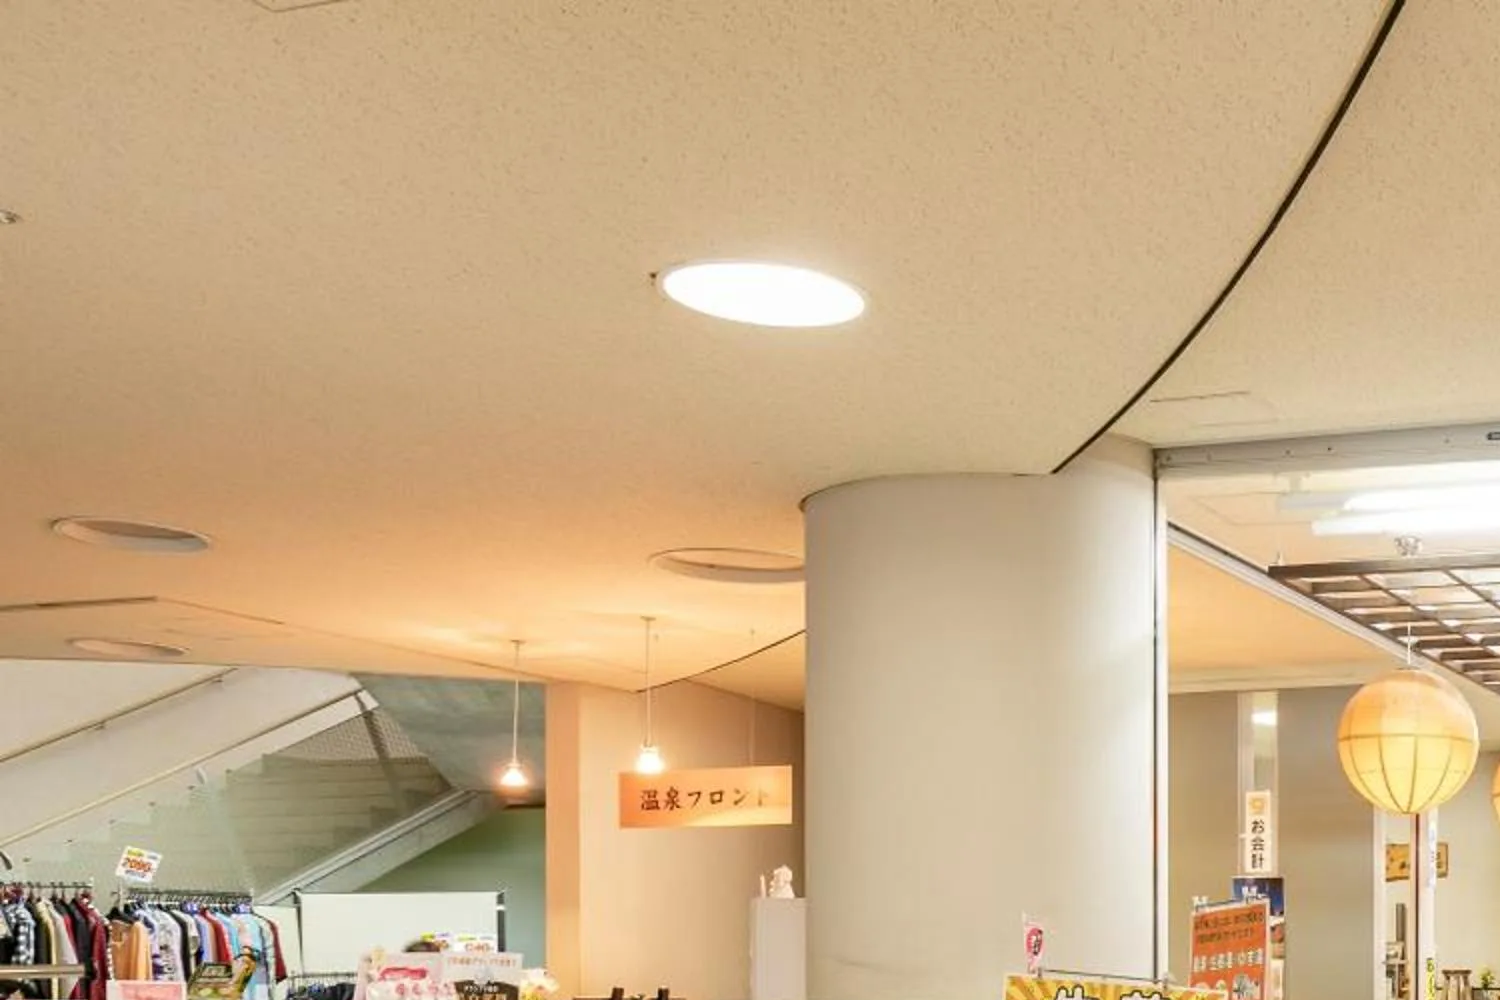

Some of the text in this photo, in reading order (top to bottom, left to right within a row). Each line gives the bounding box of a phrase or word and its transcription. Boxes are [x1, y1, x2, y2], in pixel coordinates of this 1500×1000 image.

[640, 785, 769, 811] 温泉フロント
[1251, 819, 1265, 870] お会計
